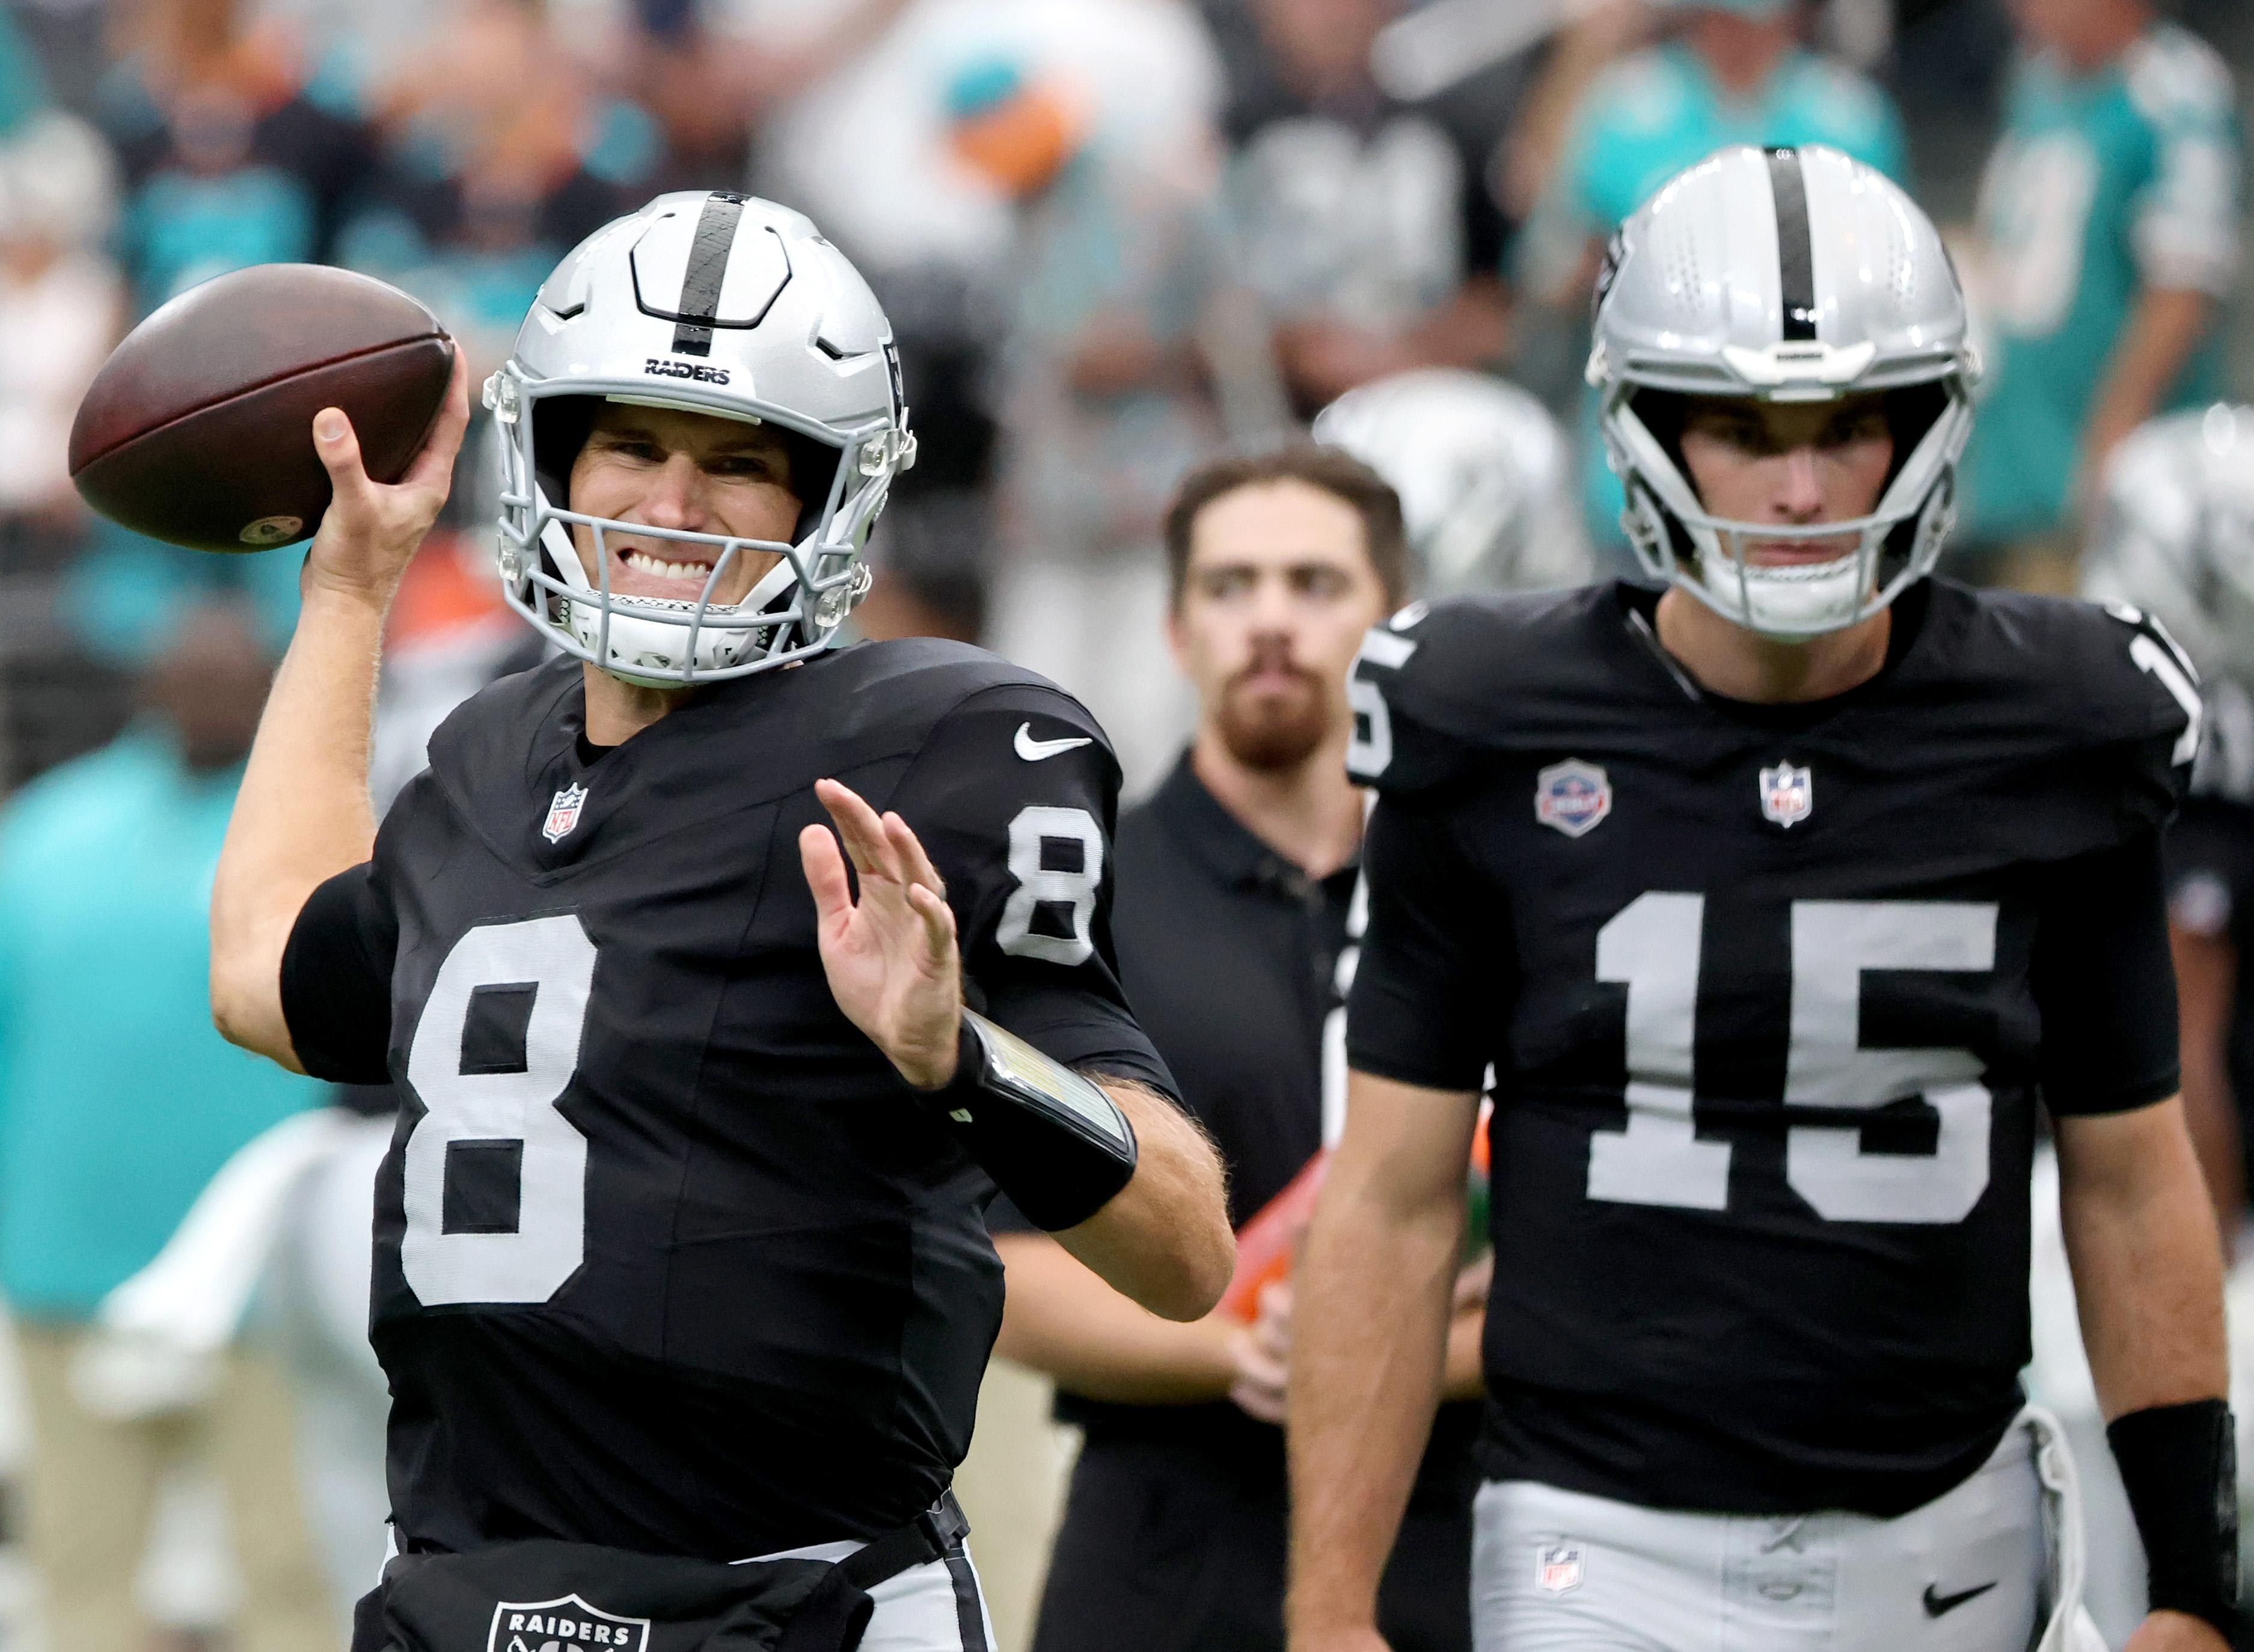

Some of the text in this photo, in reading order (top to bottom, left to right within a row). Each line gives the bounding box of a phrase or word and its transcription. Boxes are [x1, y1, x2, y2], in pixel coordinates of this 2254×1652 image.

[644, 358, 730, 385] RAIDERS
[996, 806, 1103, 966] 8
[401, 914, 598, 1306] 8
[1585, 890, 1999, 1225] 15
[508, 1614, 629, 1646] RAIDERS
